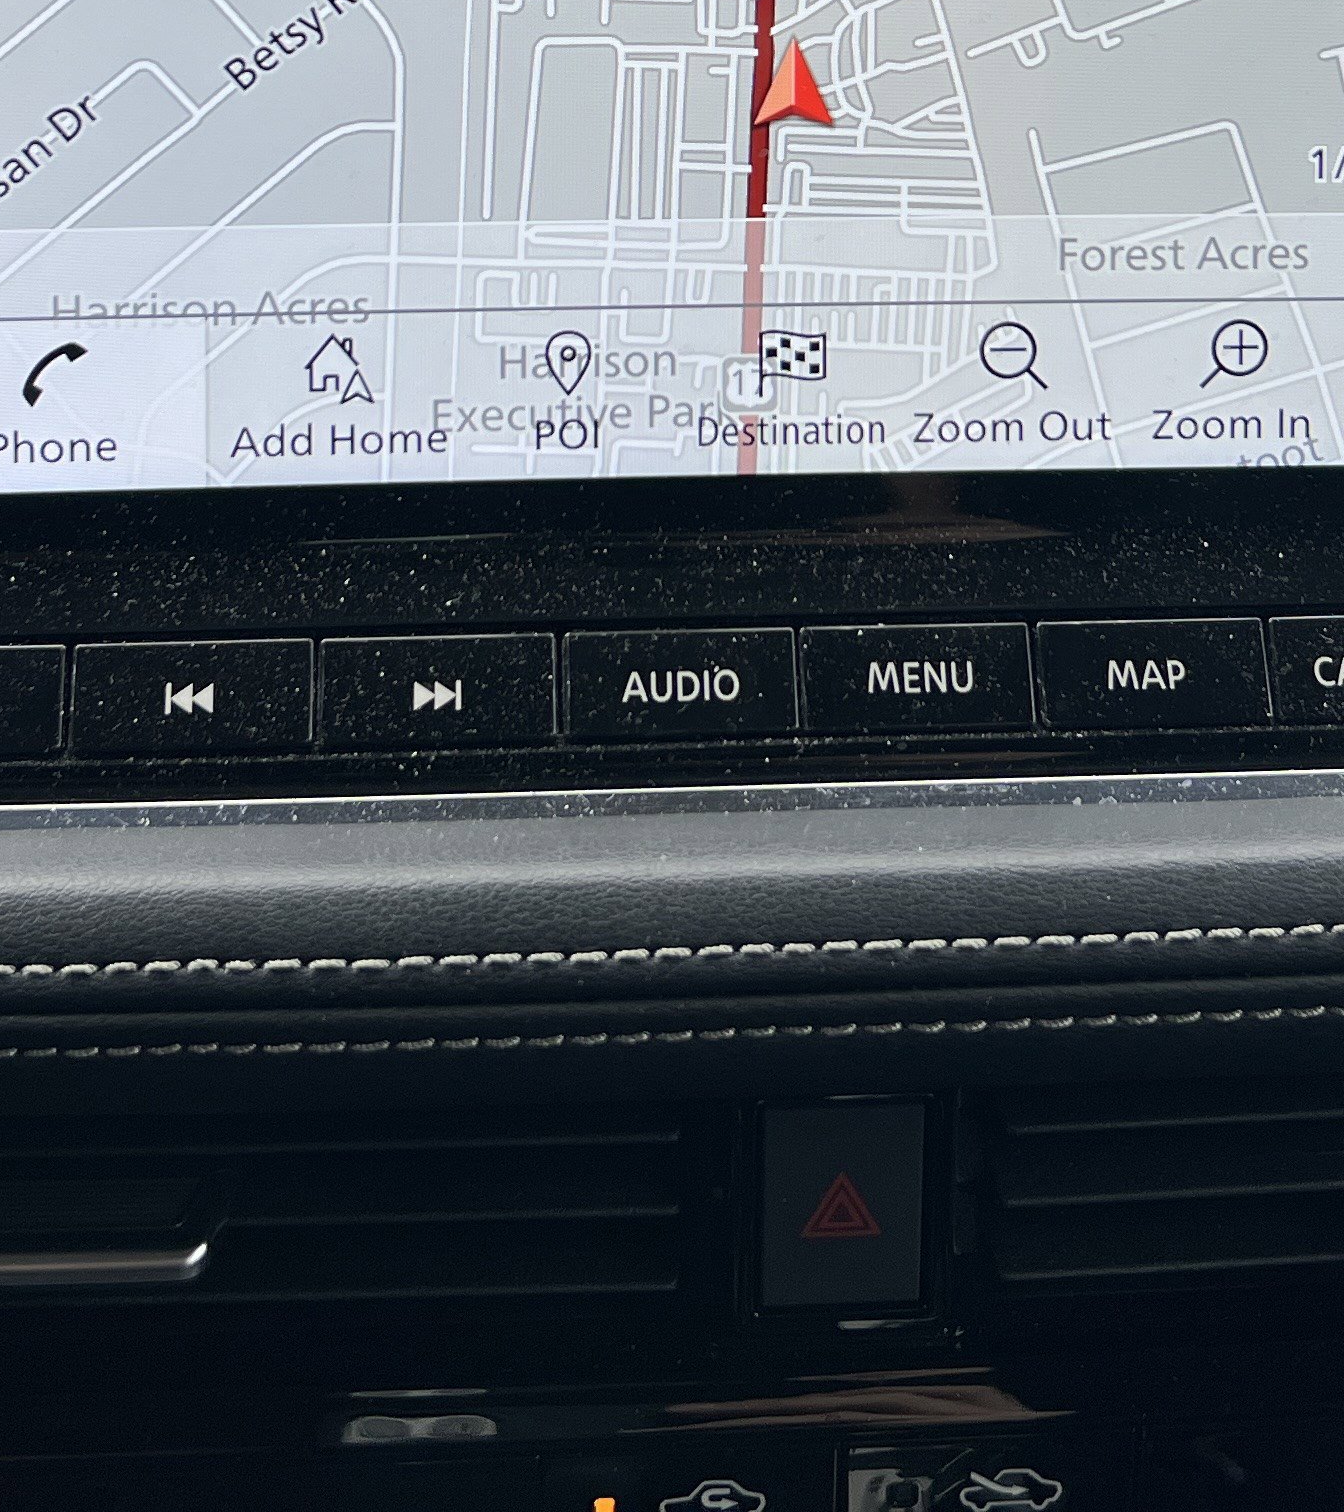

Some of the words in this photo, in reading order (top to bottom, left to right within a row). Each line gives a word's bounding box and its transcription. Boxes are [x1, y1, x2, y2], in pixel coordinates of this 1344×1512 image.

[224, 6, 325, 91] Betsy
[47, 95, 99, 143] Dr
[1059, 238, 1185, 272] Forest
[1198, 236, 1308, 271] Acres
[52, 292, 238, 328] Harrison
[253, 290, 370, 326] Acres
[500, 344, 677, 381] Harrison
[431, 396, 633, 433] Executive
[697, 414, 886, 448] Destination
[913, 413, 1026, 444] Zoom
[1038, 410, 1112, 443] Out
[1152, 409, 1262, 440] Zoom
[1278, 408, 1310, 439] In
[230, 423, 313, 459] Add
[330, 424, 448, 457] Home
[535, 419, 599, 450] POI
[622, 668, 742, 705] AUDIO
[868, 659, 974, 695] MENU
[1107, 659, 1188, 691] MAP
